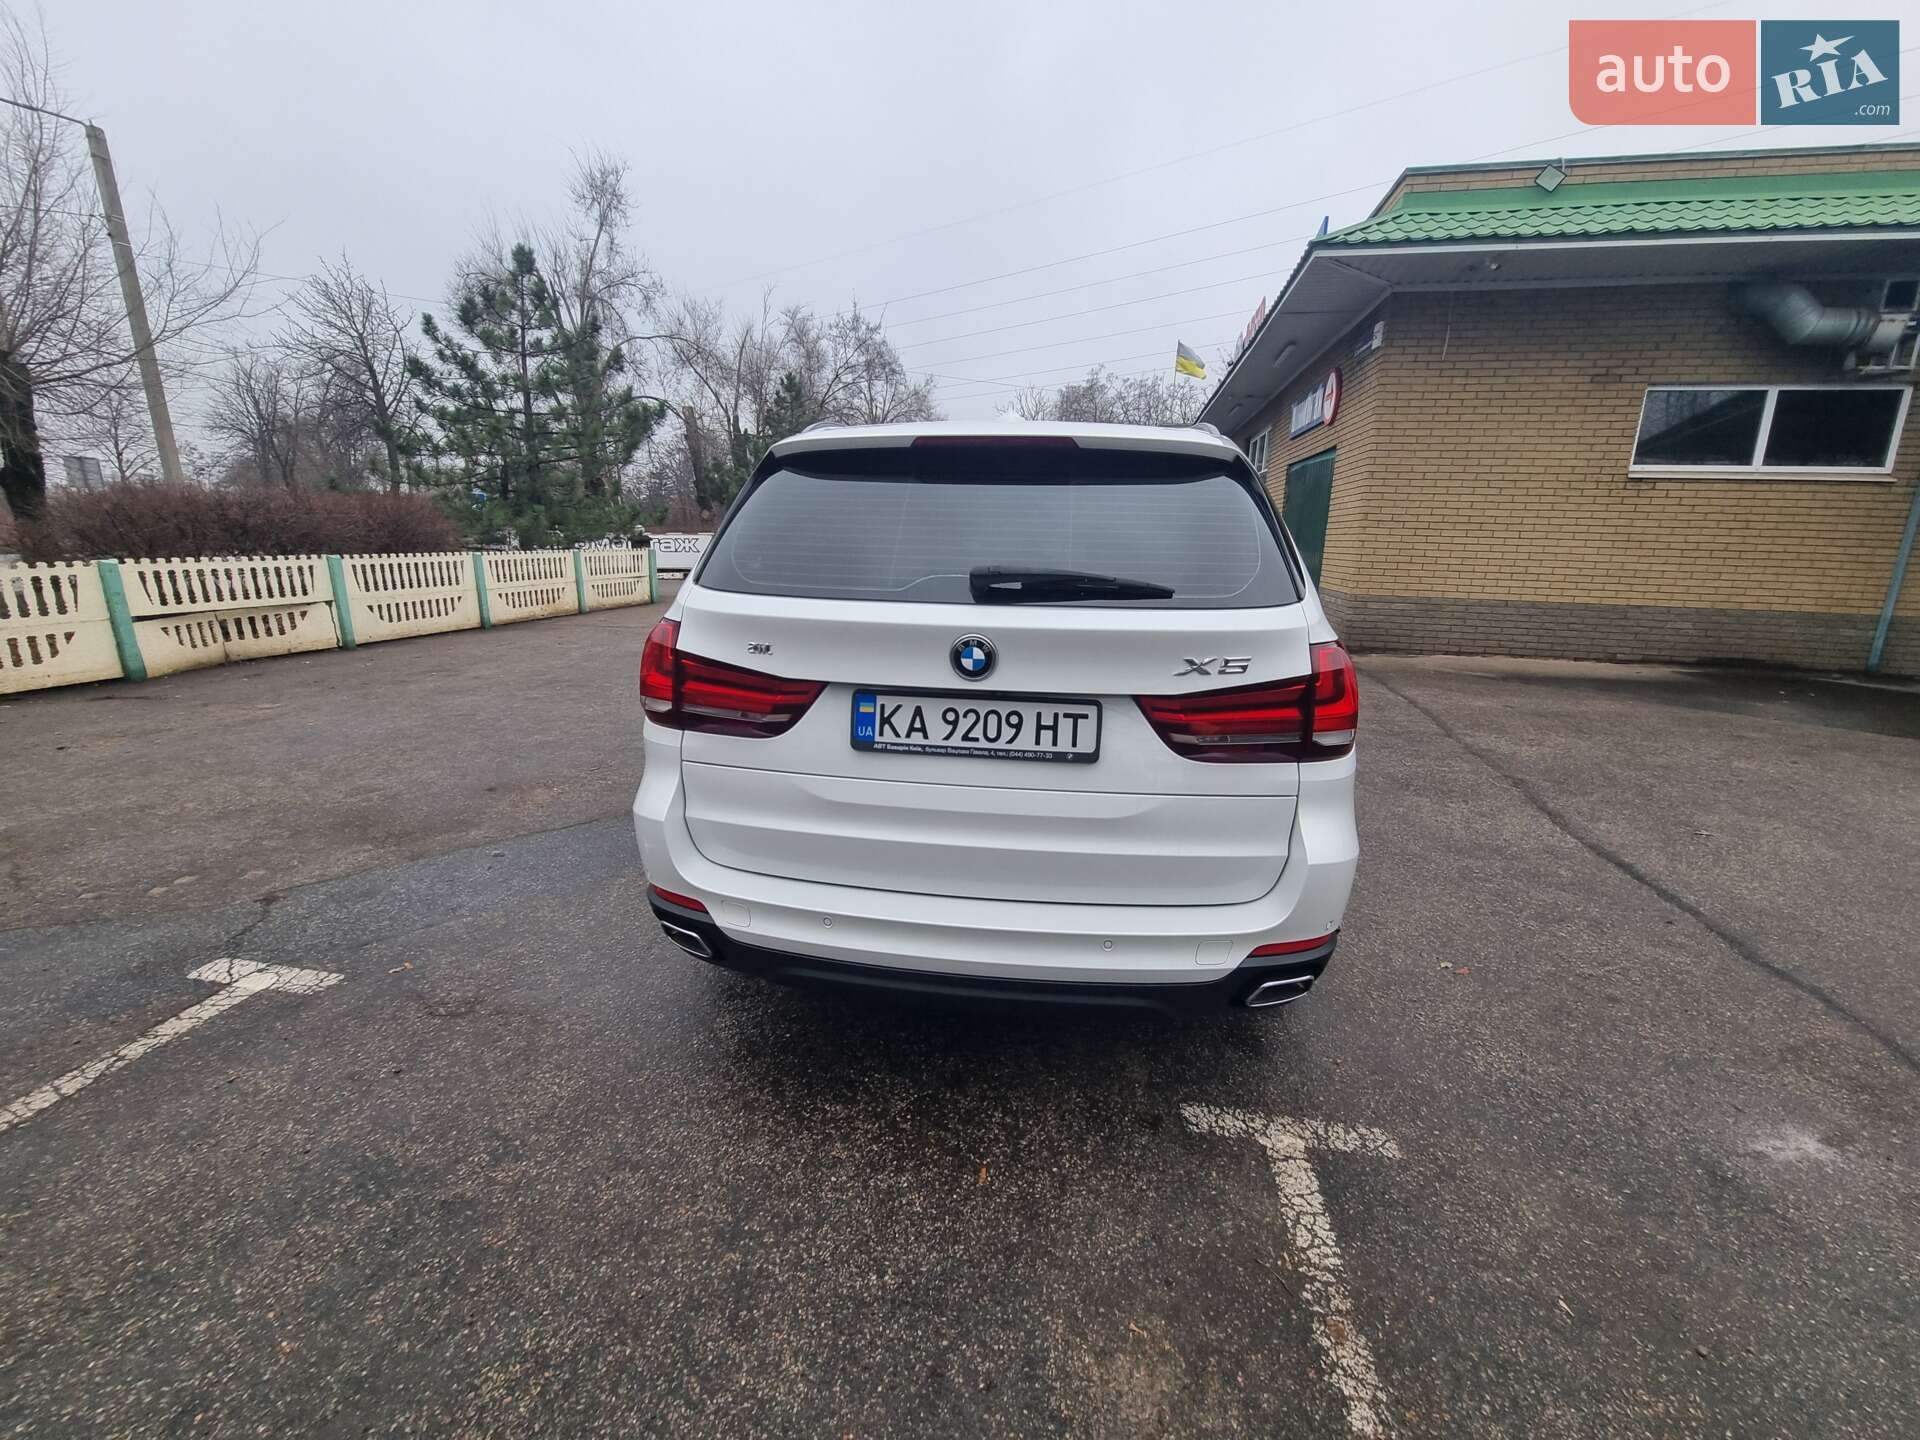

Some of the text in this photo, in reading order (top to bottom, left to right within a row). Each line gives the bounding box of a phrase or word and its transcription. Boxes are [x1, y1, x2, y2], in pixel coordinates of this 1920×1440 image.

[1171, 656, 1252, 677] X5
[857, 725, 873, 737] UA
[878, 702, 1090, 749] KA 9209 HT
